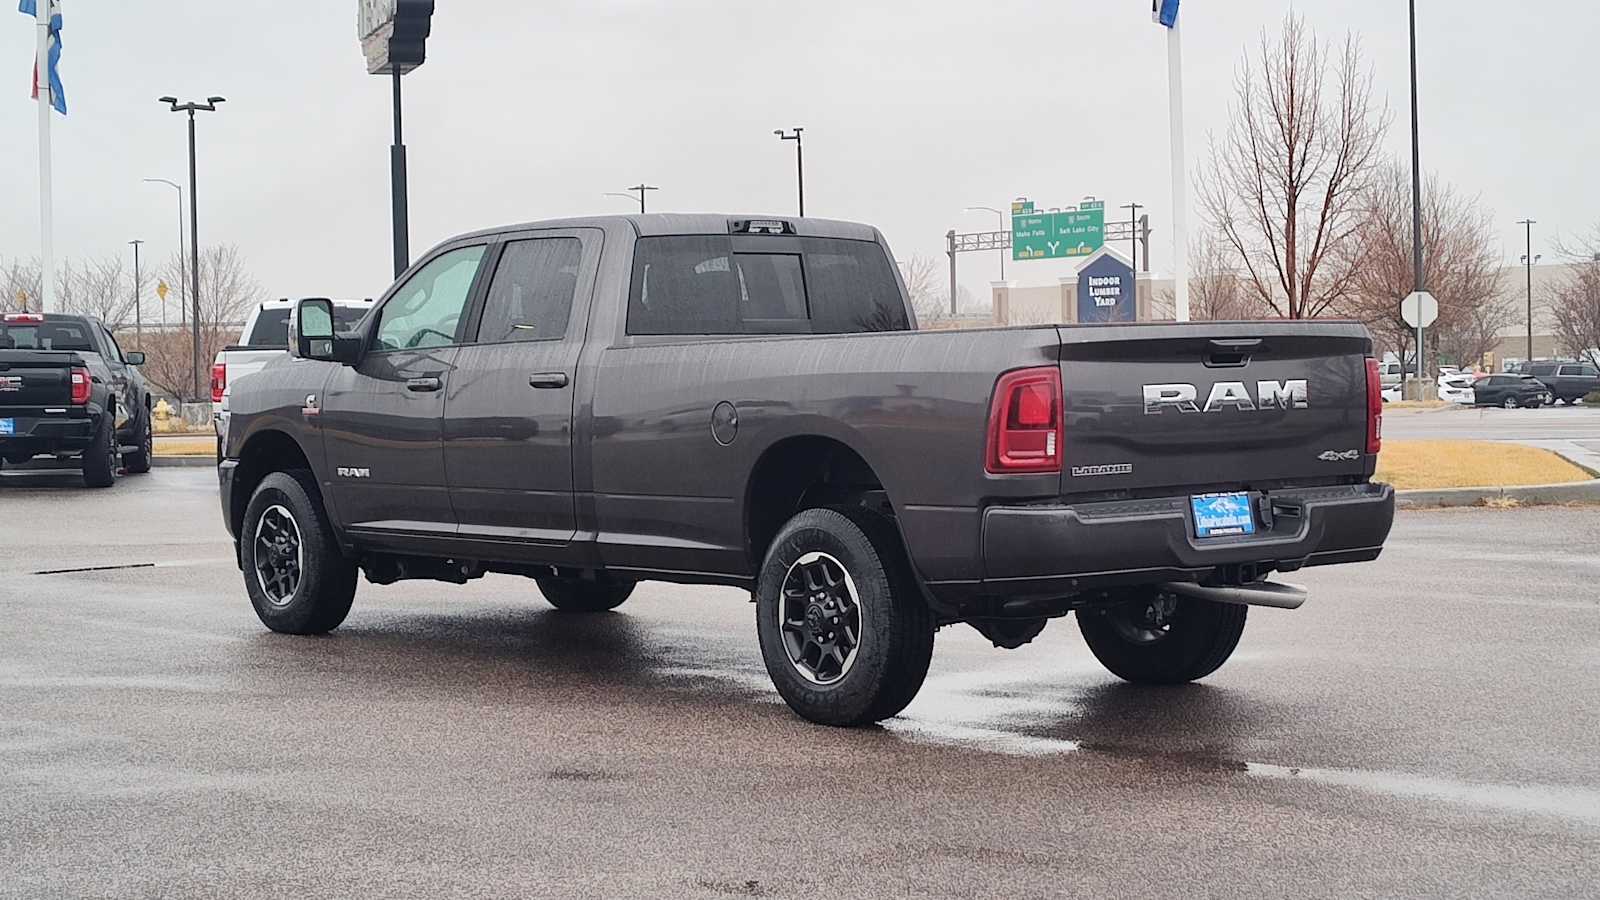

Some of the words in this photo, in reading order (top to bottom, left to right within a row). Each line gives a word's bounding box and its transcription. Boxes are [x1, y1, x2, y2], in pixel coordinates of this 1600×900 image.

[1087, 225, 1099, 233] City
[1089, 276, 1120, 286] INDOOR
[1089, 286, 1120, 297] LUMBER
[1094, 296, 1116, 307] YARD
[1143, 380, 1308, 415] RAM
[337, 467, 370, 478] RAM
[1071, 463, 1133, 477] LARAMIE
